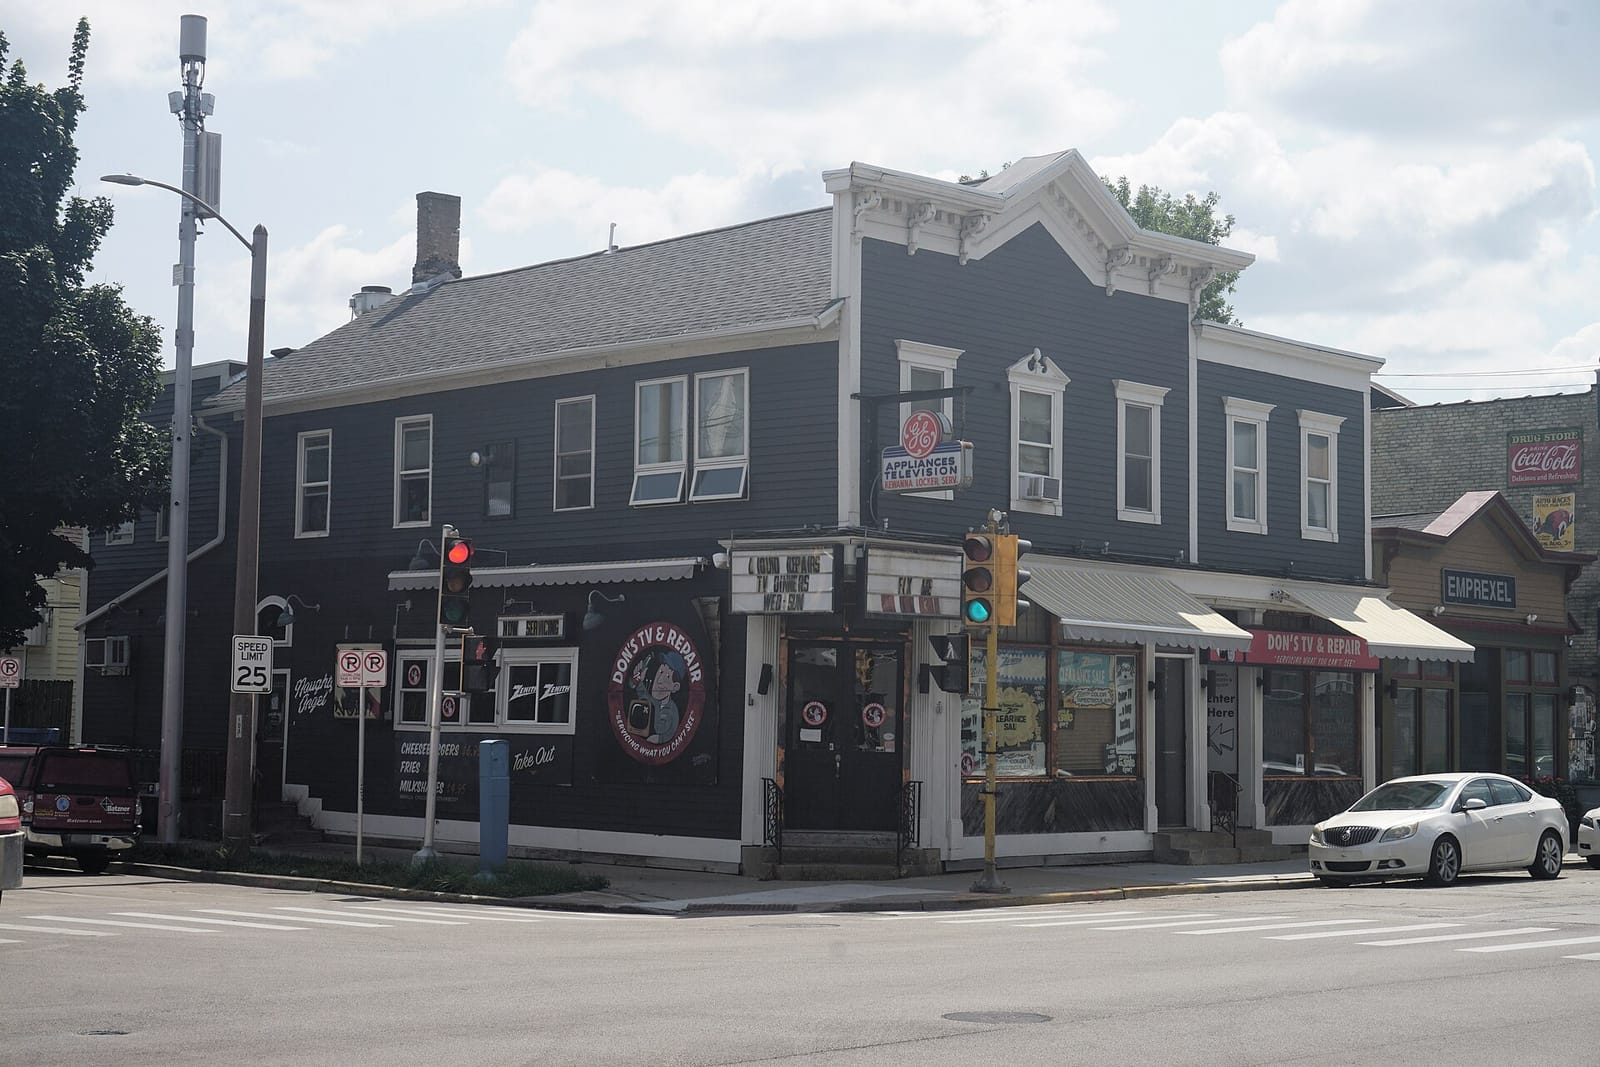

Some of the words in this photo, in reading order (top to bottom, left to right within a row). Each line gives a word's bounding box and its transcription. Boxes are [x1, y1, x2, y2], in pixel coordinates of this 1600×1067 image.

[1512, 434, 1541, 444] DRUG
[1544, 432, 1578, 442] STORE
[886, 457, 955, 471] APPLIANCES
[884, 466, 958, 480] TELEVISION
[757, 575, 768, 592] TV
[774, 574, 810, 592] DINNERS
[898, 576, 912, 594] FIX
[1448, 576, 1512, 602] EMPREXEL
[502, 621, 519, 636] NOW
[238, 642, 268, 652] SPEED
[1268, 634, 1299, 652] DON'S
[1302, 636, 1314, 652] TV
[1316, 637, 1324, 653] &
[1328, 638, 1360, 655] REPAIR
[241, 652, 264, 661] LIMIT
[612, 637, 639, 684] DON'S
[638, 627, 653, 647] TV
[656, 626, 665, 642] &
[667, 628, 702, 684] REPAIR
[238, 666, 267, 686] 25
[1208, 708, 1234, 718] Here
[639, 746, 659, 758] WHAT
[658, 745, 670, 757] YOU
[512, 752, 534, 772] Take
[536, 746, 556, 766] Out
[400, 761, 421, 774] FRIES
